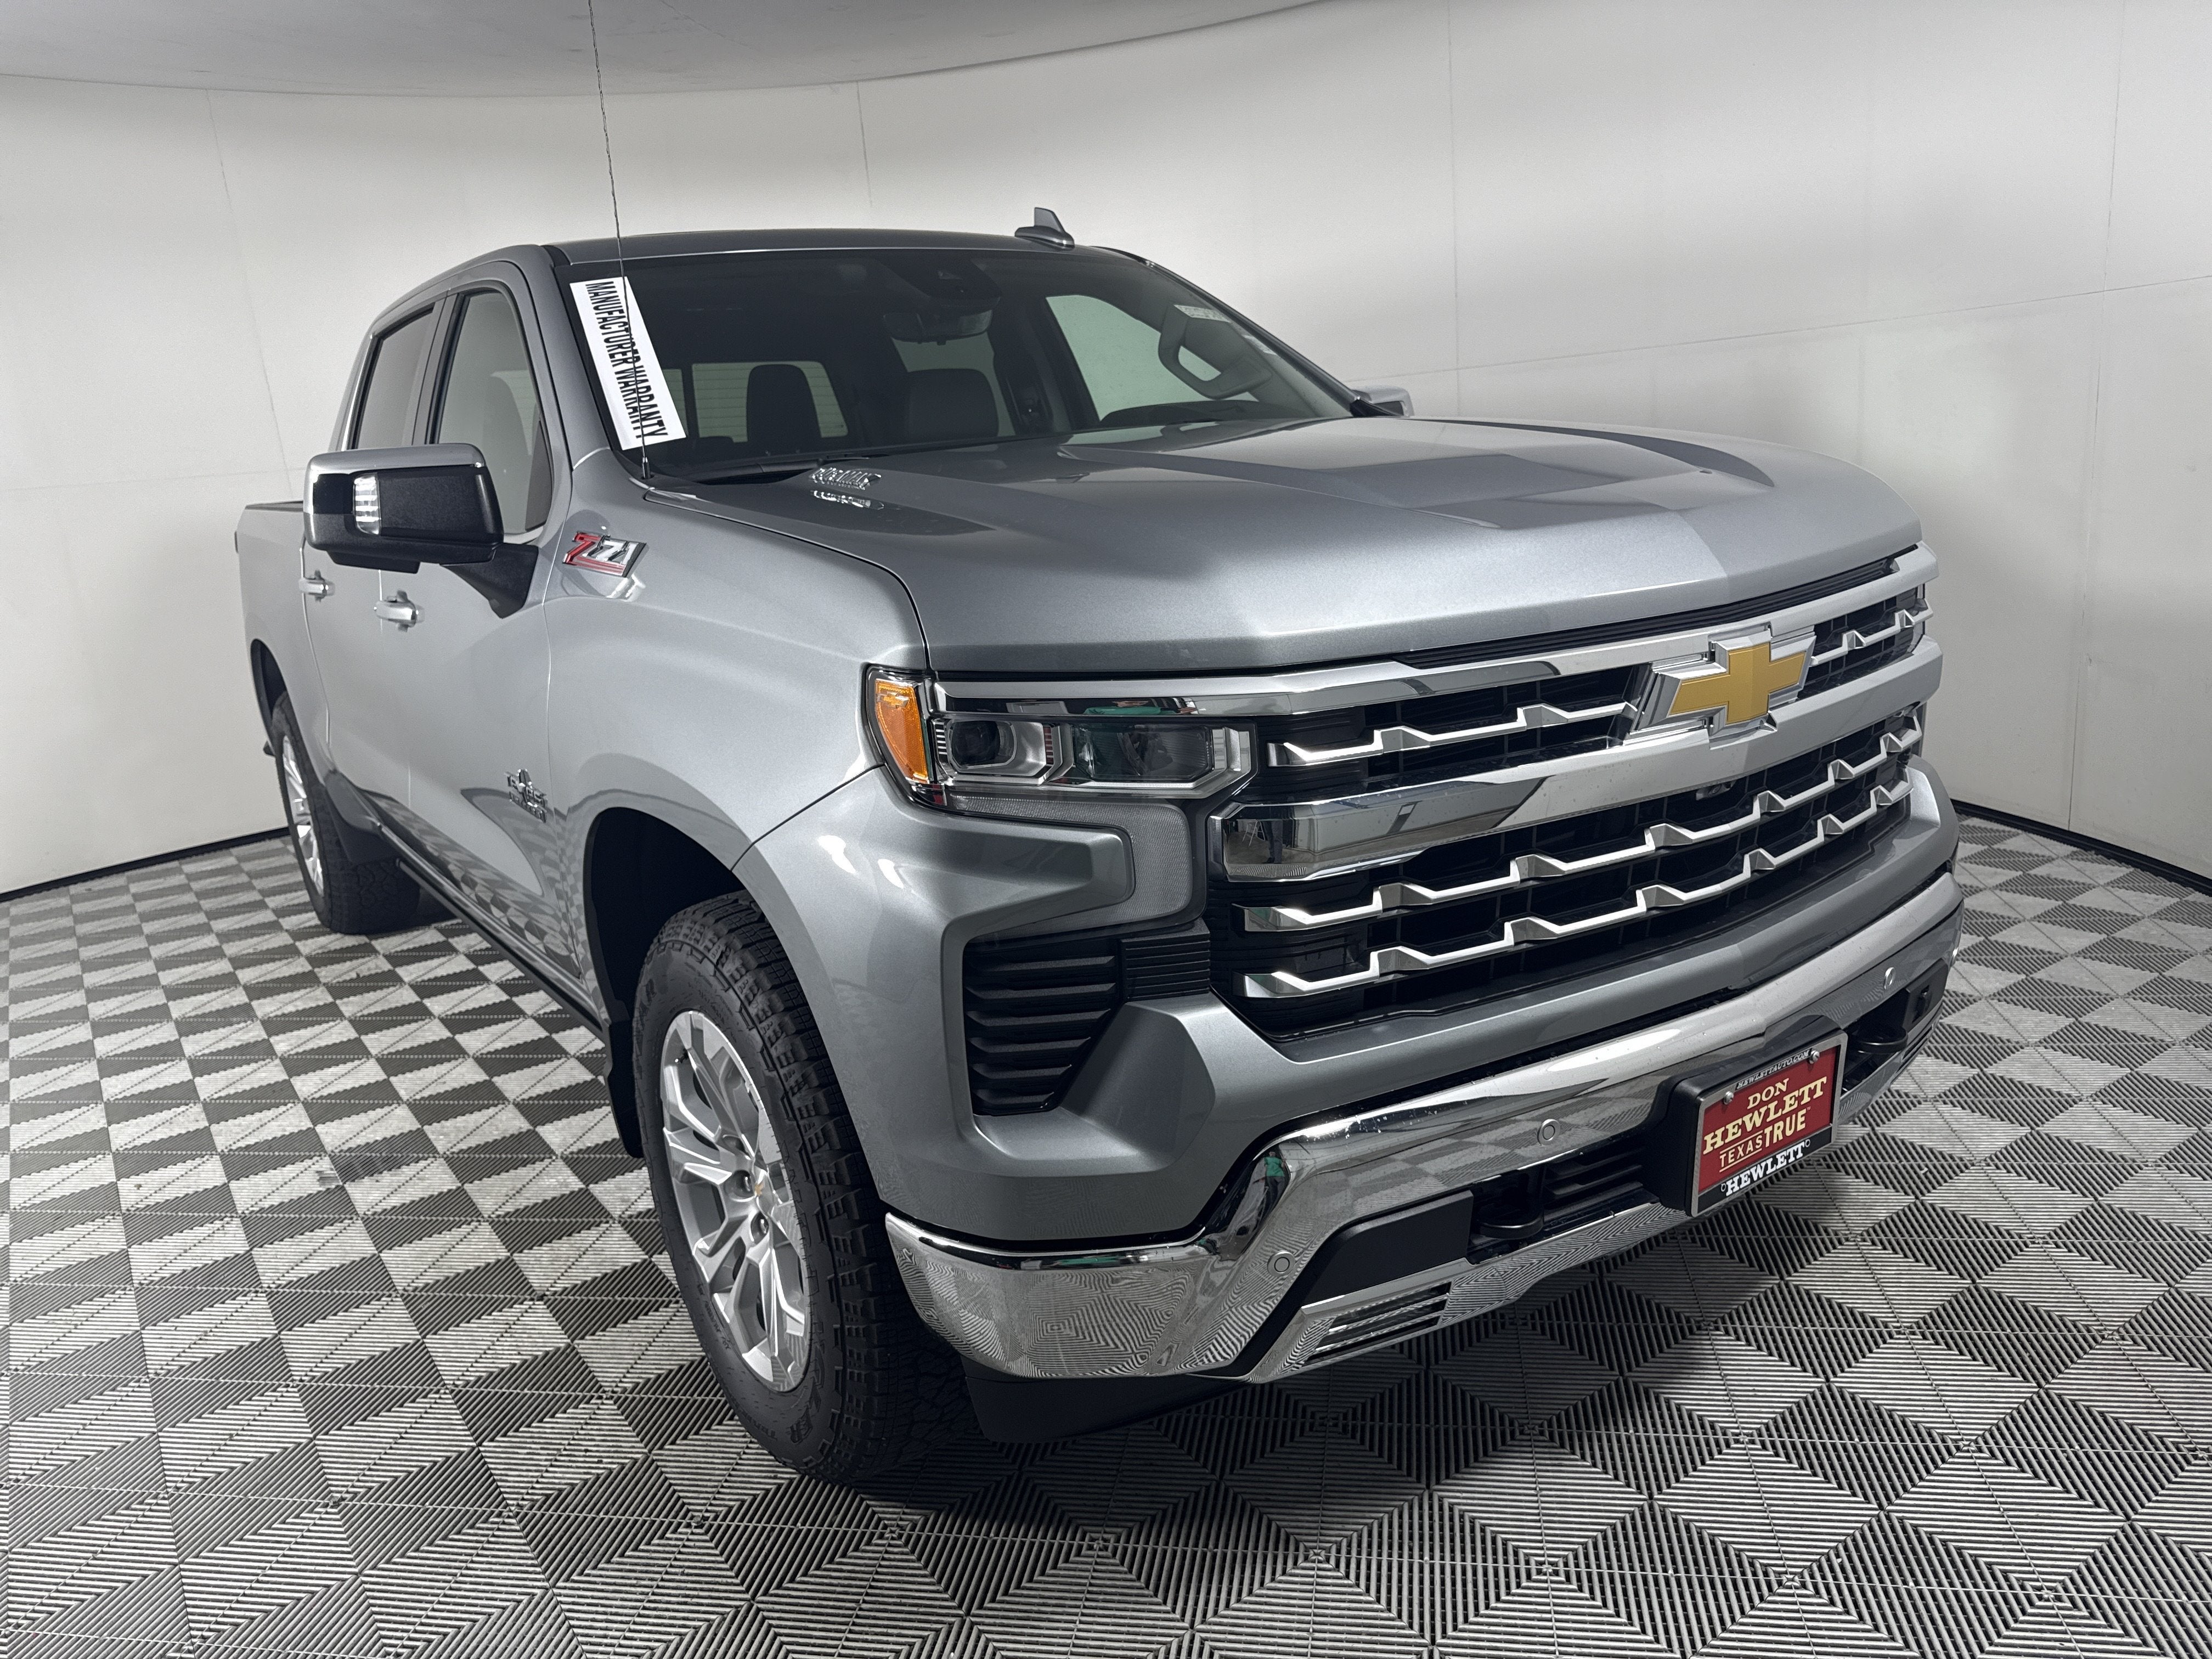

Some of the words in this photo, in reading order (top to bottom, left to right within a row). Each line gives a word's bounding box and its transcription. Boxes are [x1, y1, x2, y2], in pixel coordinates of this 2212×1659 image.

[585, 281, 641, 368] MANUFACTURER
[614, 364, 668, 439] WARRANTY
[563, 531, 647, 578] Z71
[1736, 1049, 1810, 1090] HEWLETTAUTO.COM
[1747, 1077, 1790, 1110] DON
[1703, 1076, 1827, 1155] HEWLETT
[1726, 1142, 1805, 1196] HEWLETT
